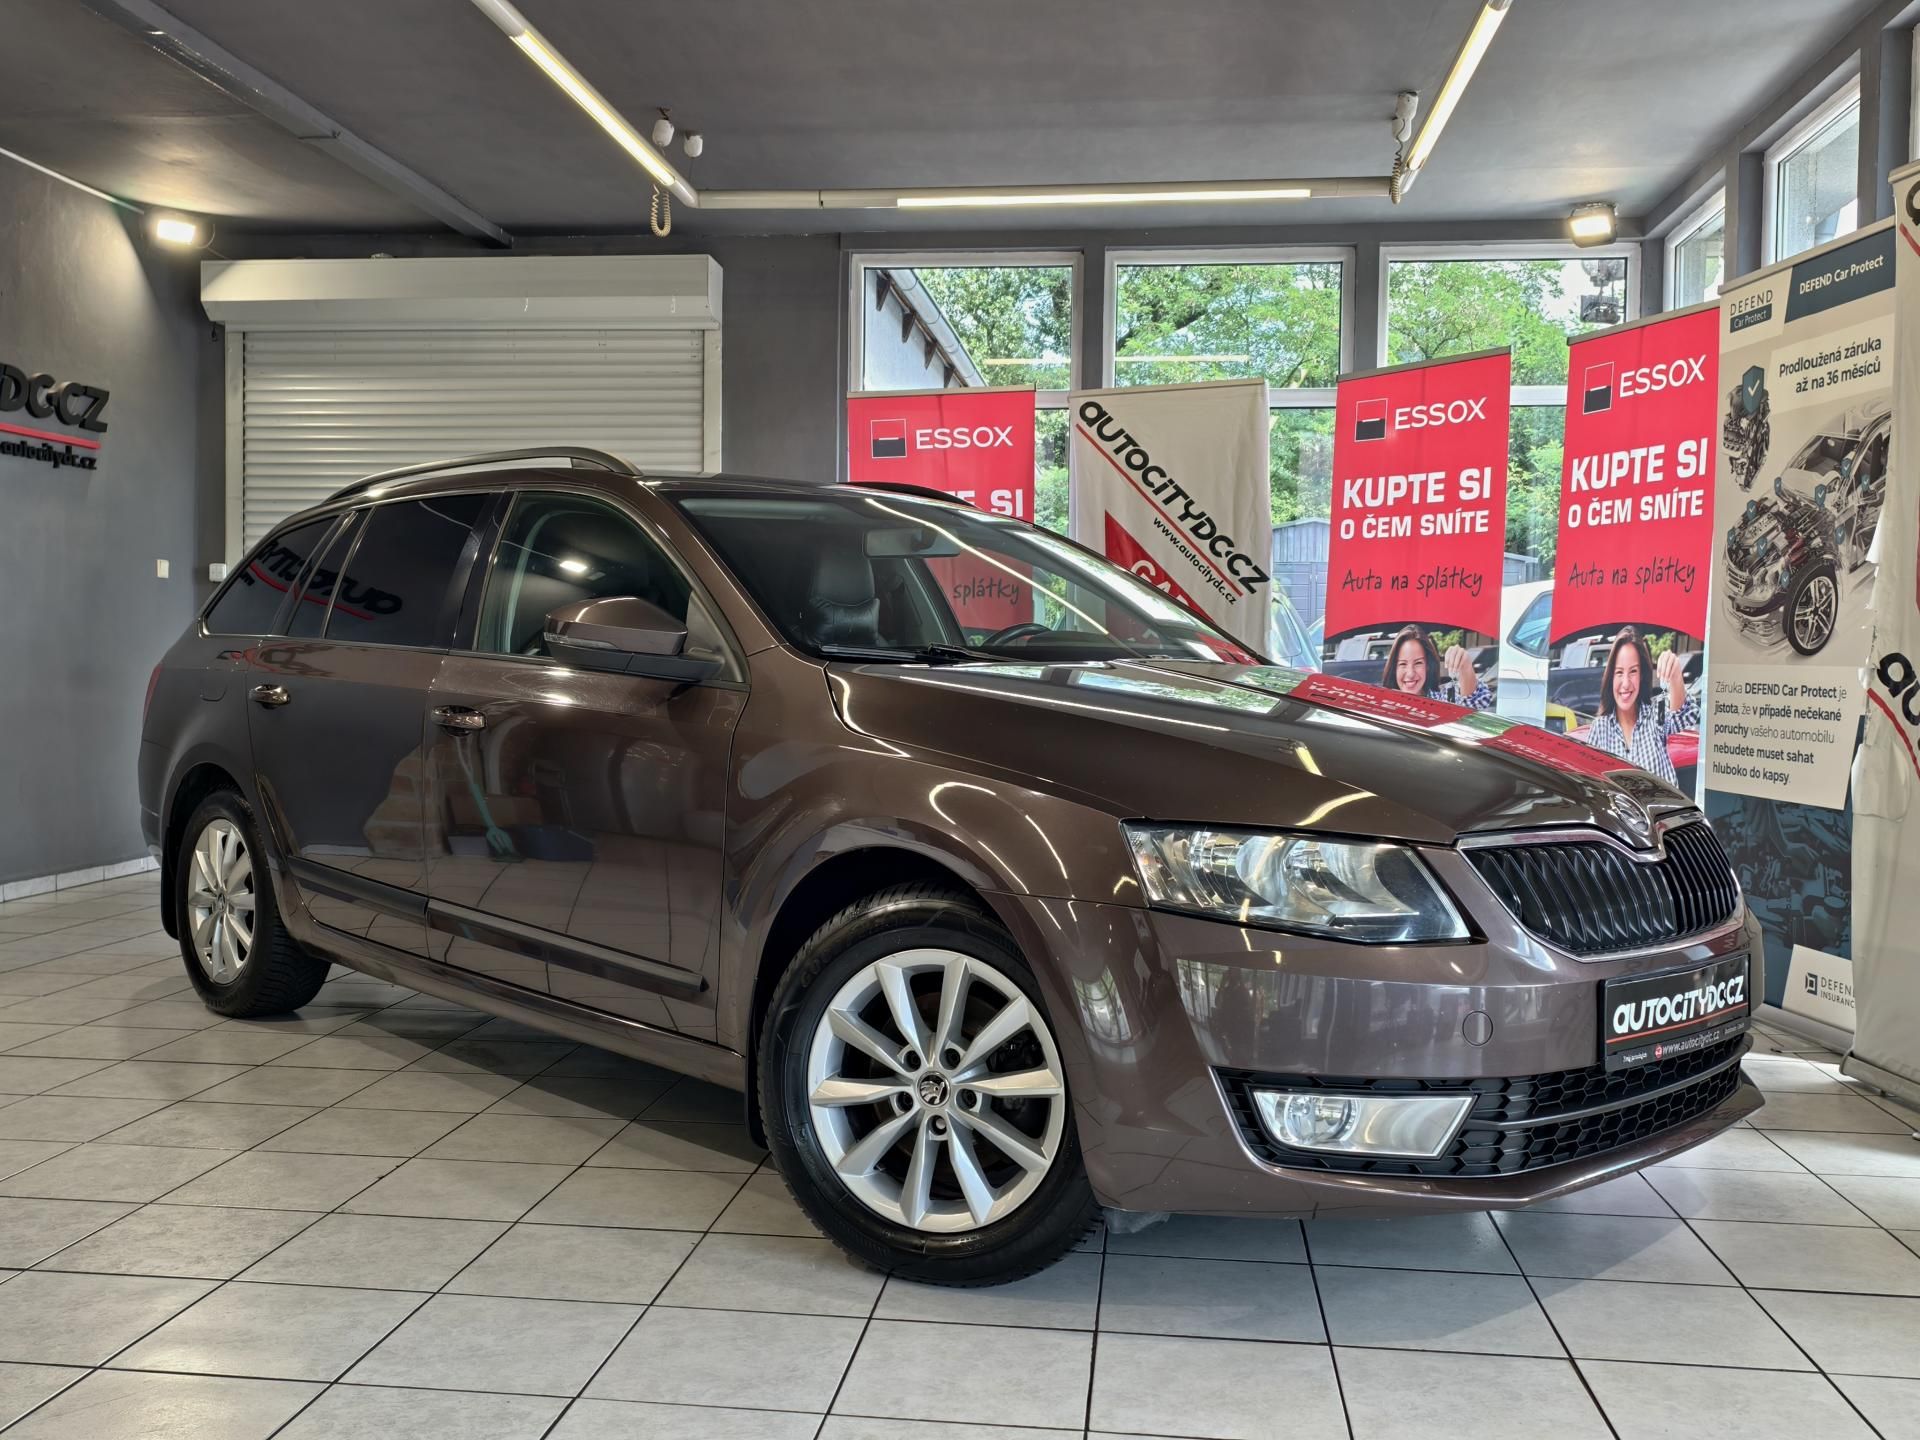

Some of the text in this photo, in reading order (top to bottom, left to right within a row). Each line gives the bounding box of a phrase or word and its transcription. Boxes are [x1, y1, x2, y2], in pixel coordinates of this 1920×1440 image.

[1800, 254, 1884, 294] DEFEND Car Protect
[1730, 289, 1774, 316] DEFEND
[1733, 309, 1767, 329] Car Protect
[1779, 336, 1882, 378] Prodloužená záruka
[1619, 354, 1707, 399] ESSOX
[1796, 355, 1881, 394] až na 36 měsíců
[1394, 396, 1488, 431] ESSOX
[915, 425, 1014, 450] ESSOX
[1570, 437, 1709, 493] KUPTE SI
[990, 488, 1024, 518] SI
[1343, 466, 1492, 509] KUPTE SI
[1567, 486, 1705, 528] O ČEM SNÍTE
[1340, 507, 1490, 540] O ČEM SNÍTE
[1153, 516, 1237, 606] www.autocitydc.cz
[1568, 556, 1696, 594] Auta na splátky
[953, 576, 1020, 605] splátky
[1342, 566, 1483, 598] Auta na splátky
[1715, 681, 1847, 702] Záruka DEFEND Car Protect je
[1714, 700, 1842, 721] jistota, že v případě nečekané
[1714, 723, 1835, 744] poruchy vašeho automobilu
[1713, 742, 1815, 764] nebudete muset sahat
[1712, 761, 1791, 786] hluboko do kapsy.
[1820, 990, 1857, 1009] INSURANC
